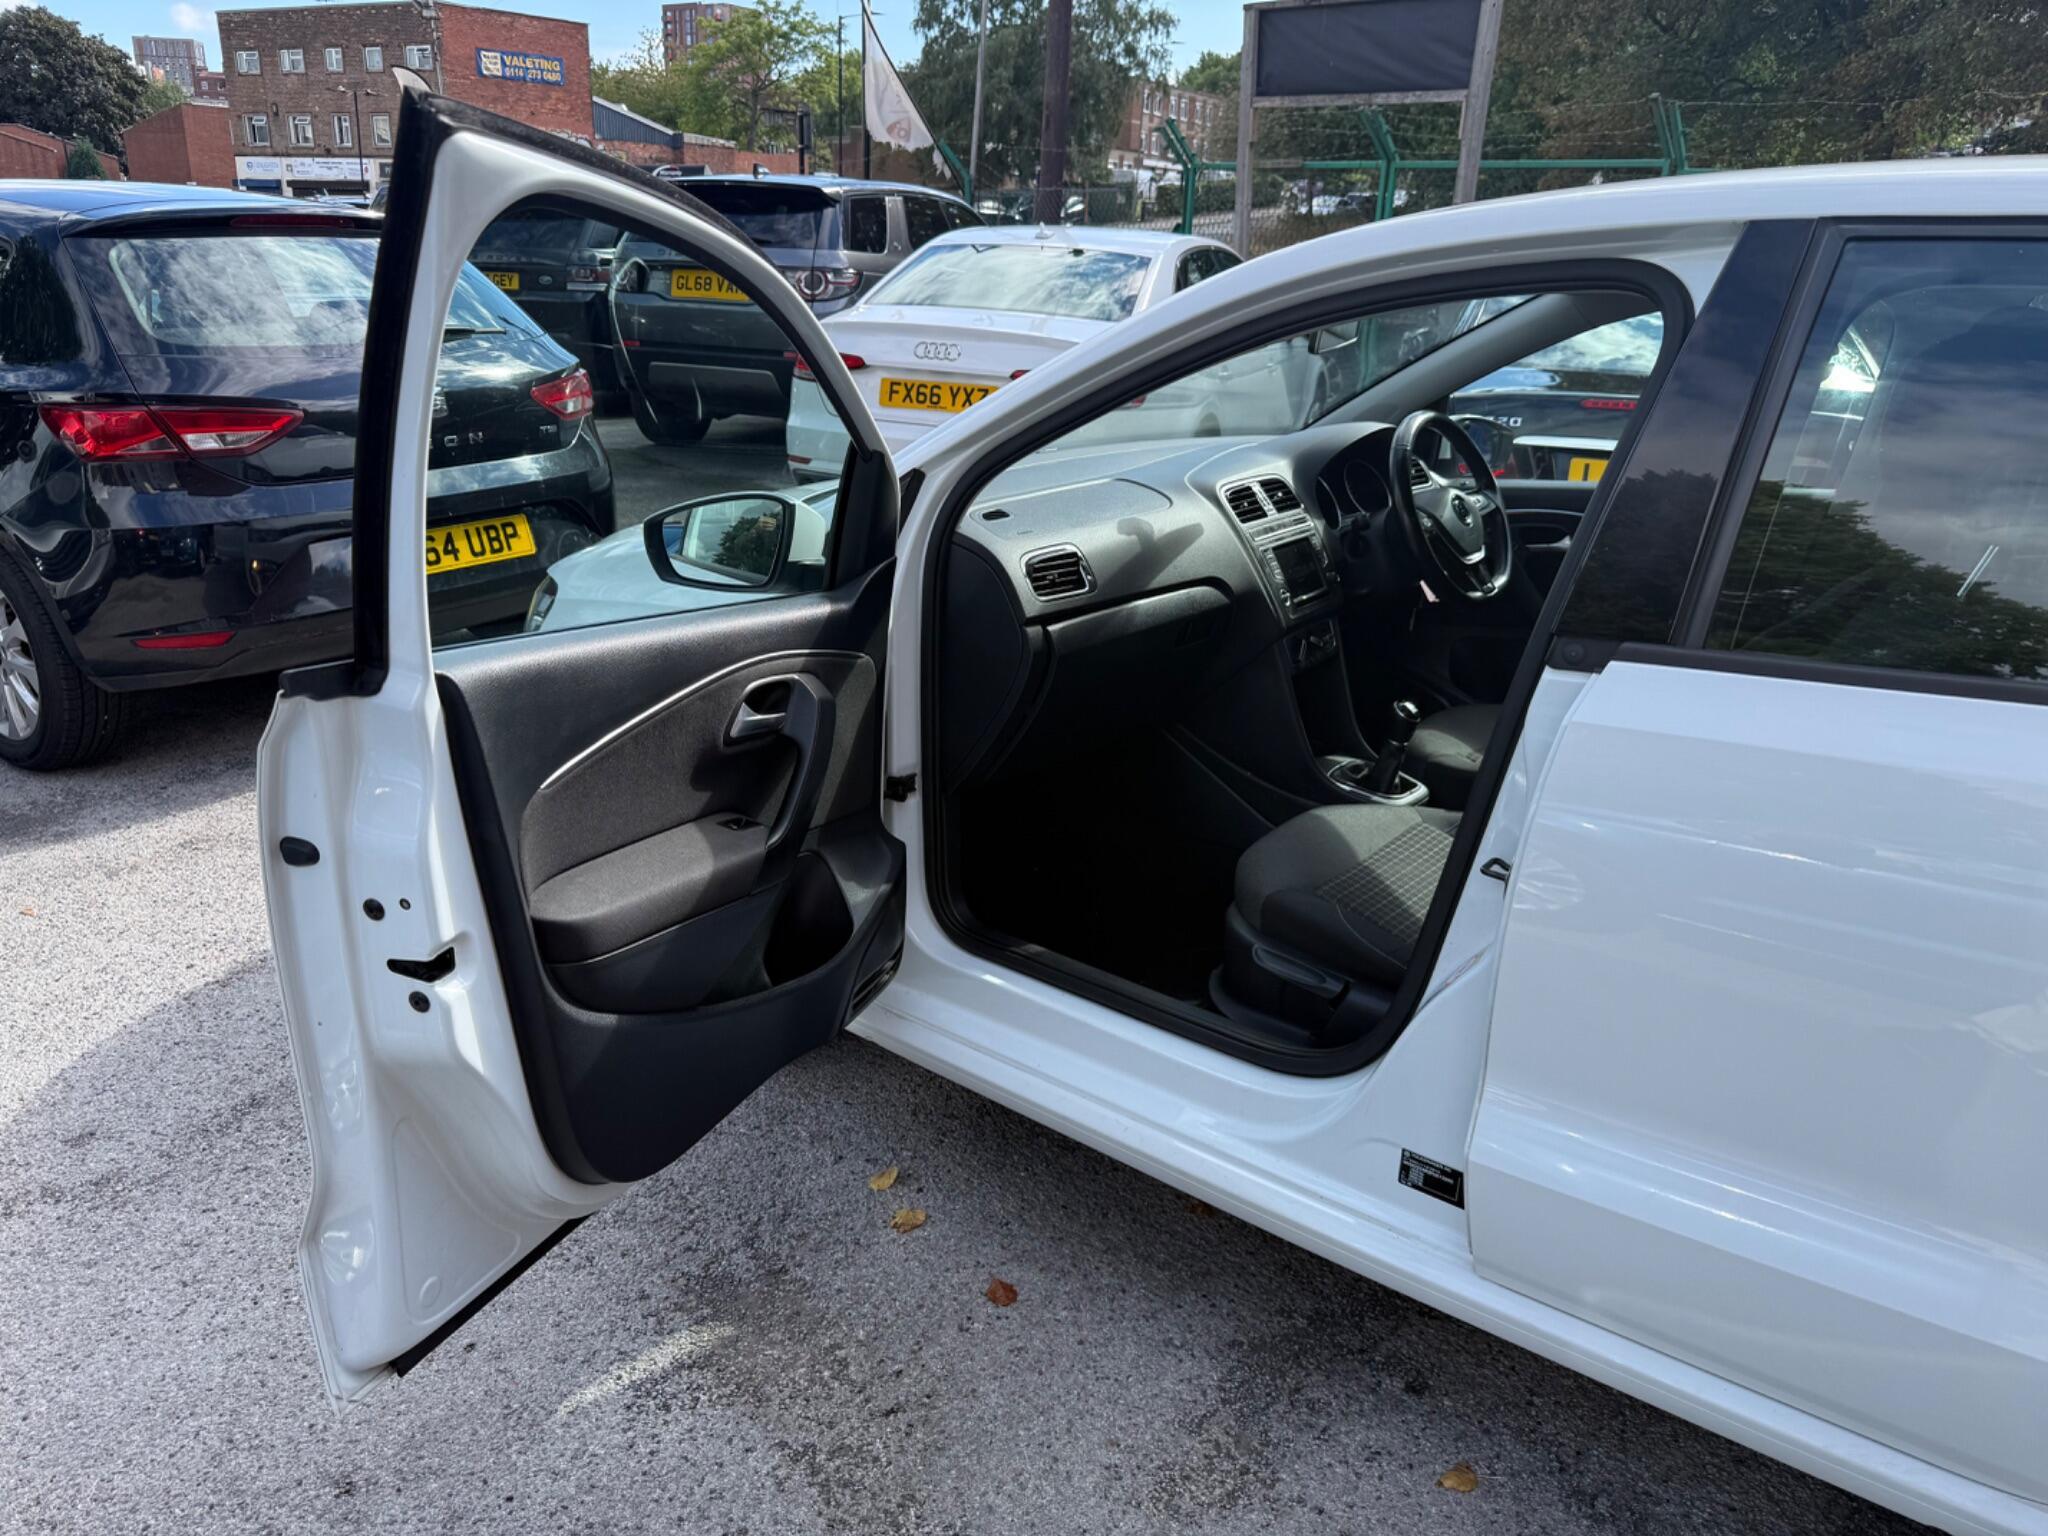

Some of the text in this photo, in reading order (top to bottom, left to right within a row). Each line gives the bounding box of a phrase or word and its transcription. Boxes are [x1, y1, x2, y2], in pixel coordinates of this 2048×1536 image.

[504, 55, 561, 71] VALETING
[676, 275, 712, 292] GL68
[888, 381, 942, 406] FX66
[464, 521, 520, 558] UBP
